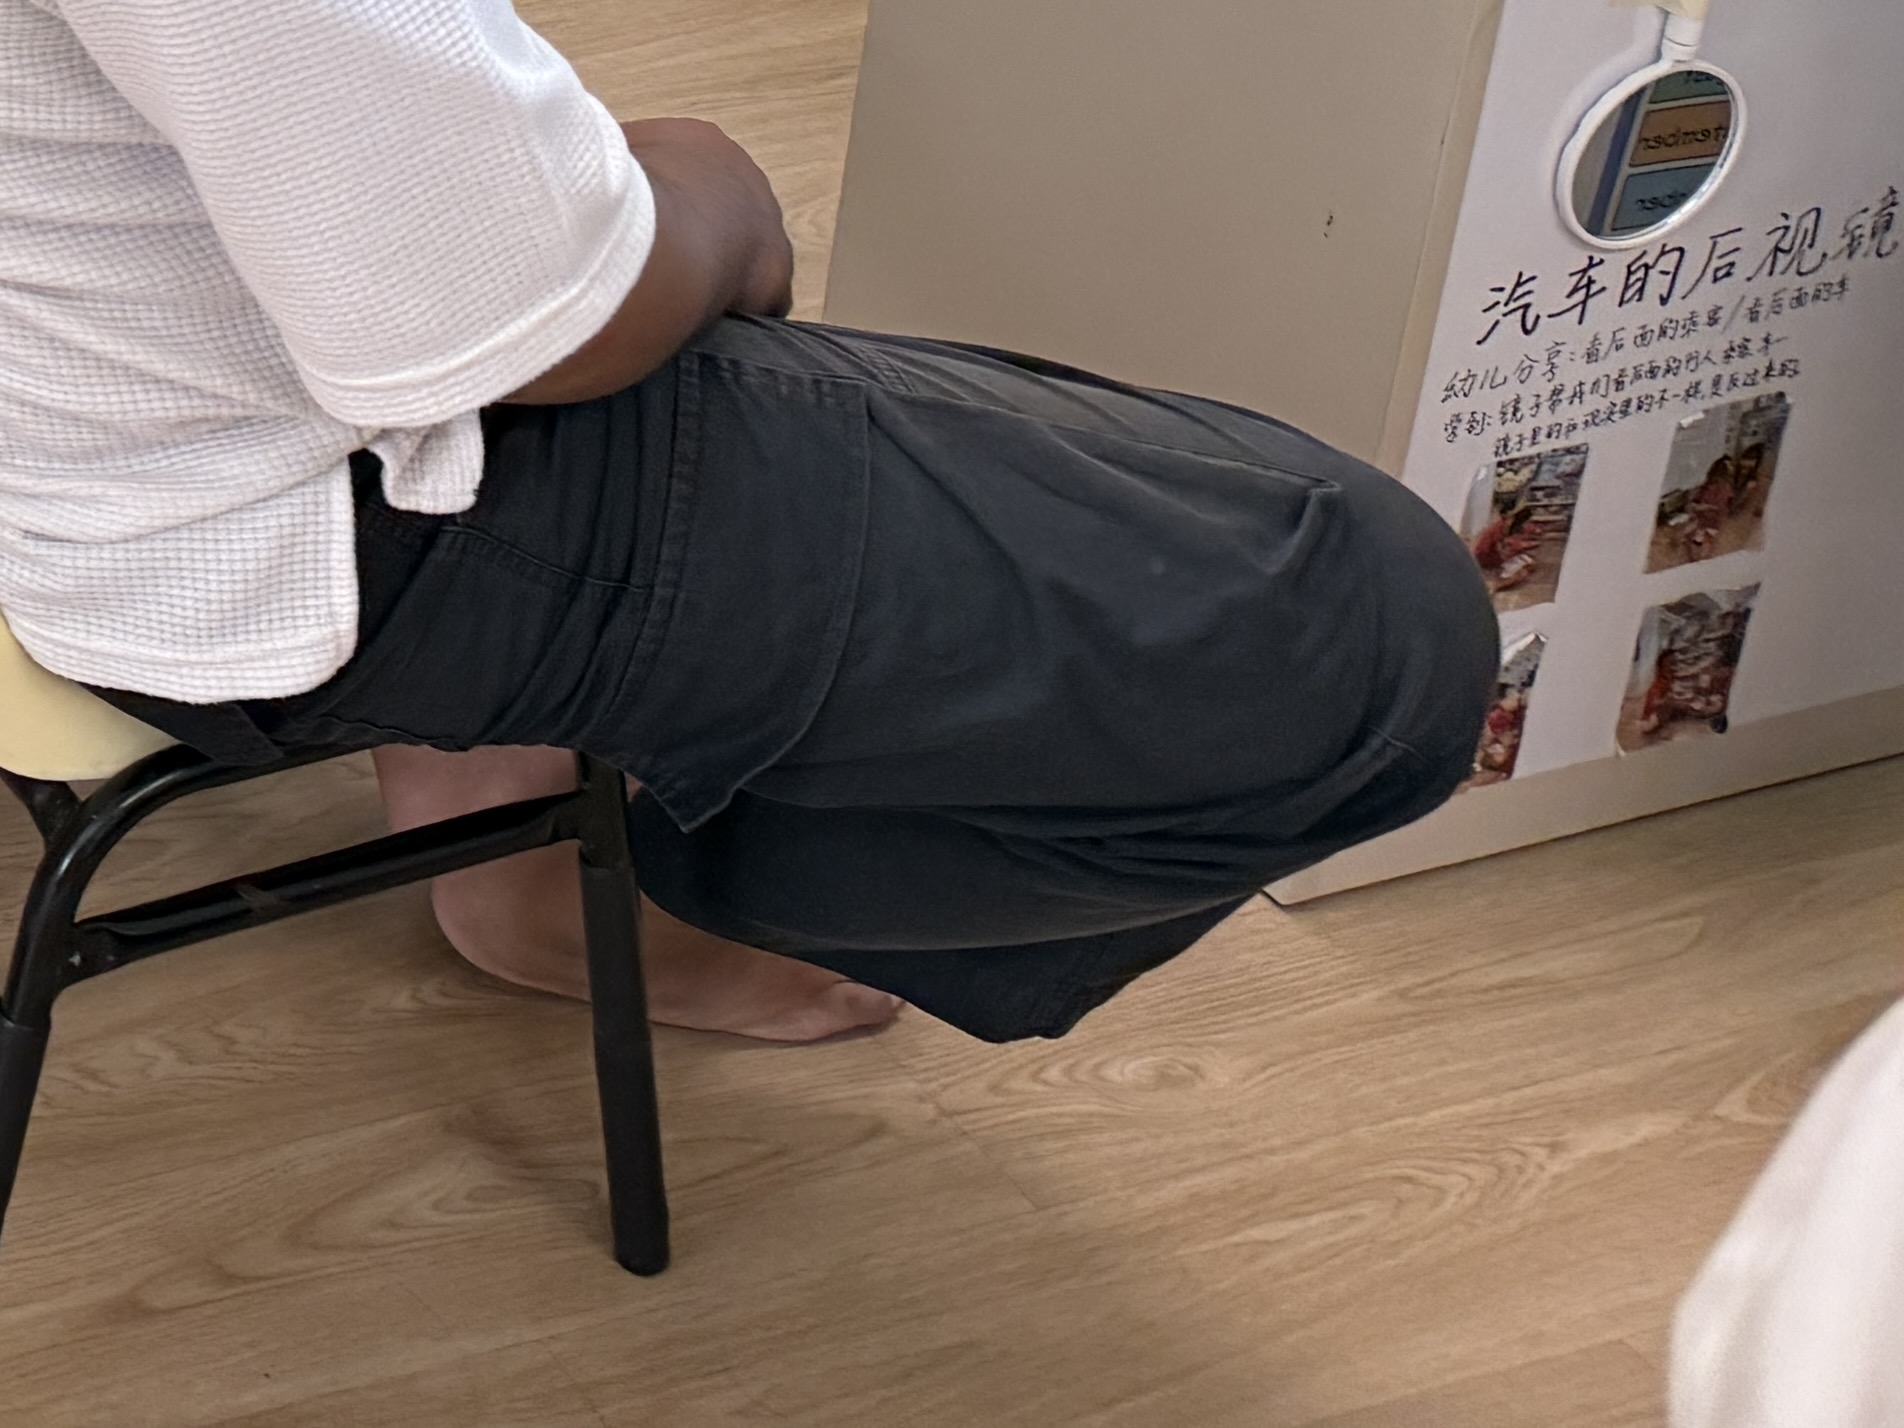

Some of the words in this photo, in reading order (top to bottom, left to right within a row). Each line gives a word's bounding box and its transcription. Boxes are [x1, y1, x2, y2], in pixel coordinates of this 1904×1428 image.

[1476, 185, 1903, 346] 汽车的后视镜
